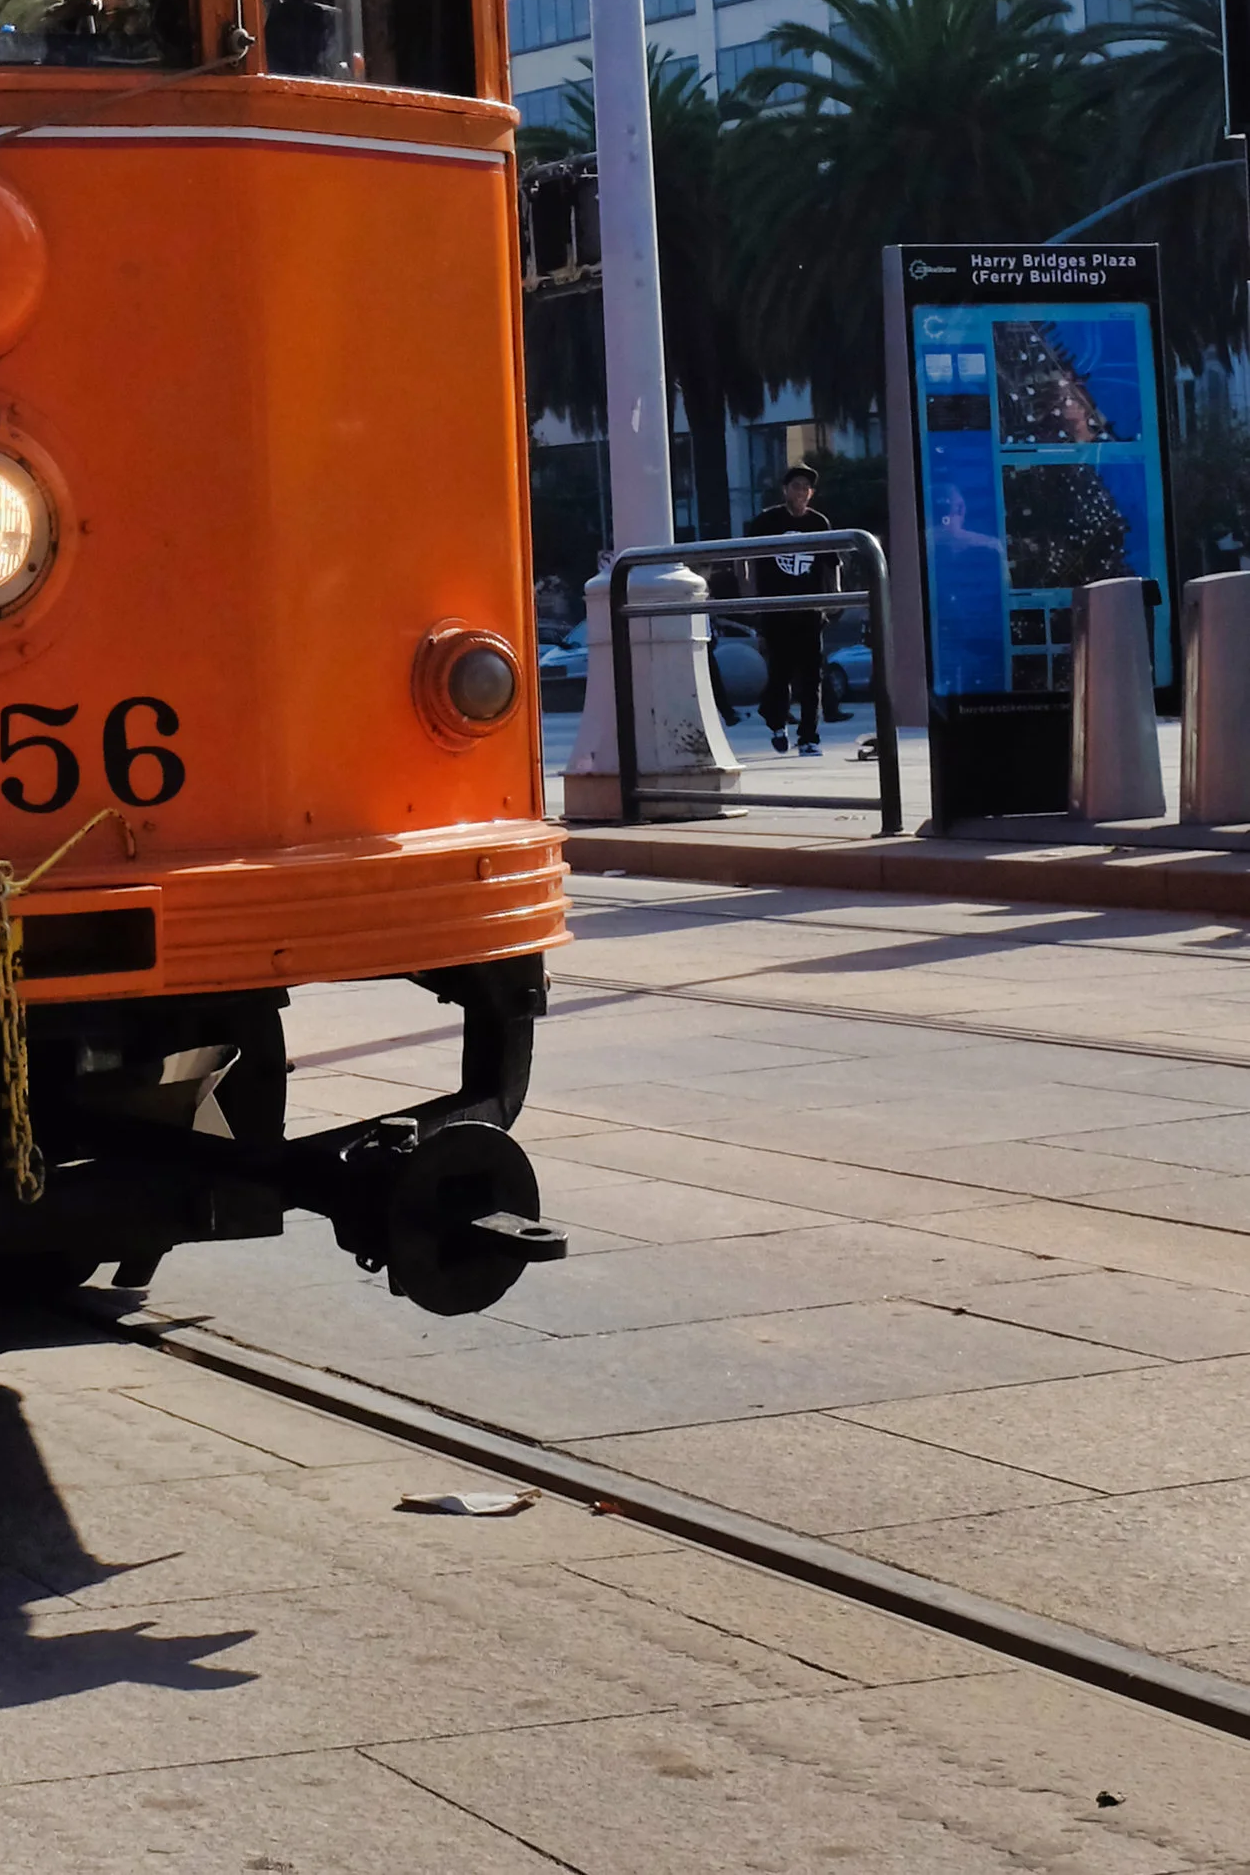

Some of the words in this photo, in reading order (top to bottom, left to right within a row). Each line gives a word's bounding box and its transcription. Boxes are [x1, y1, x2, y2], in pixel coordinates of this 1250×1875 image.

[971, 253, 1016, 269] Harry
[1022, 253, 1087, 269] Bridges
[1092, 253, 1137, 268] Plaza
[972, 270, 1024, 286] (Ferry
[1029, 269, 1107, 286] Building)
